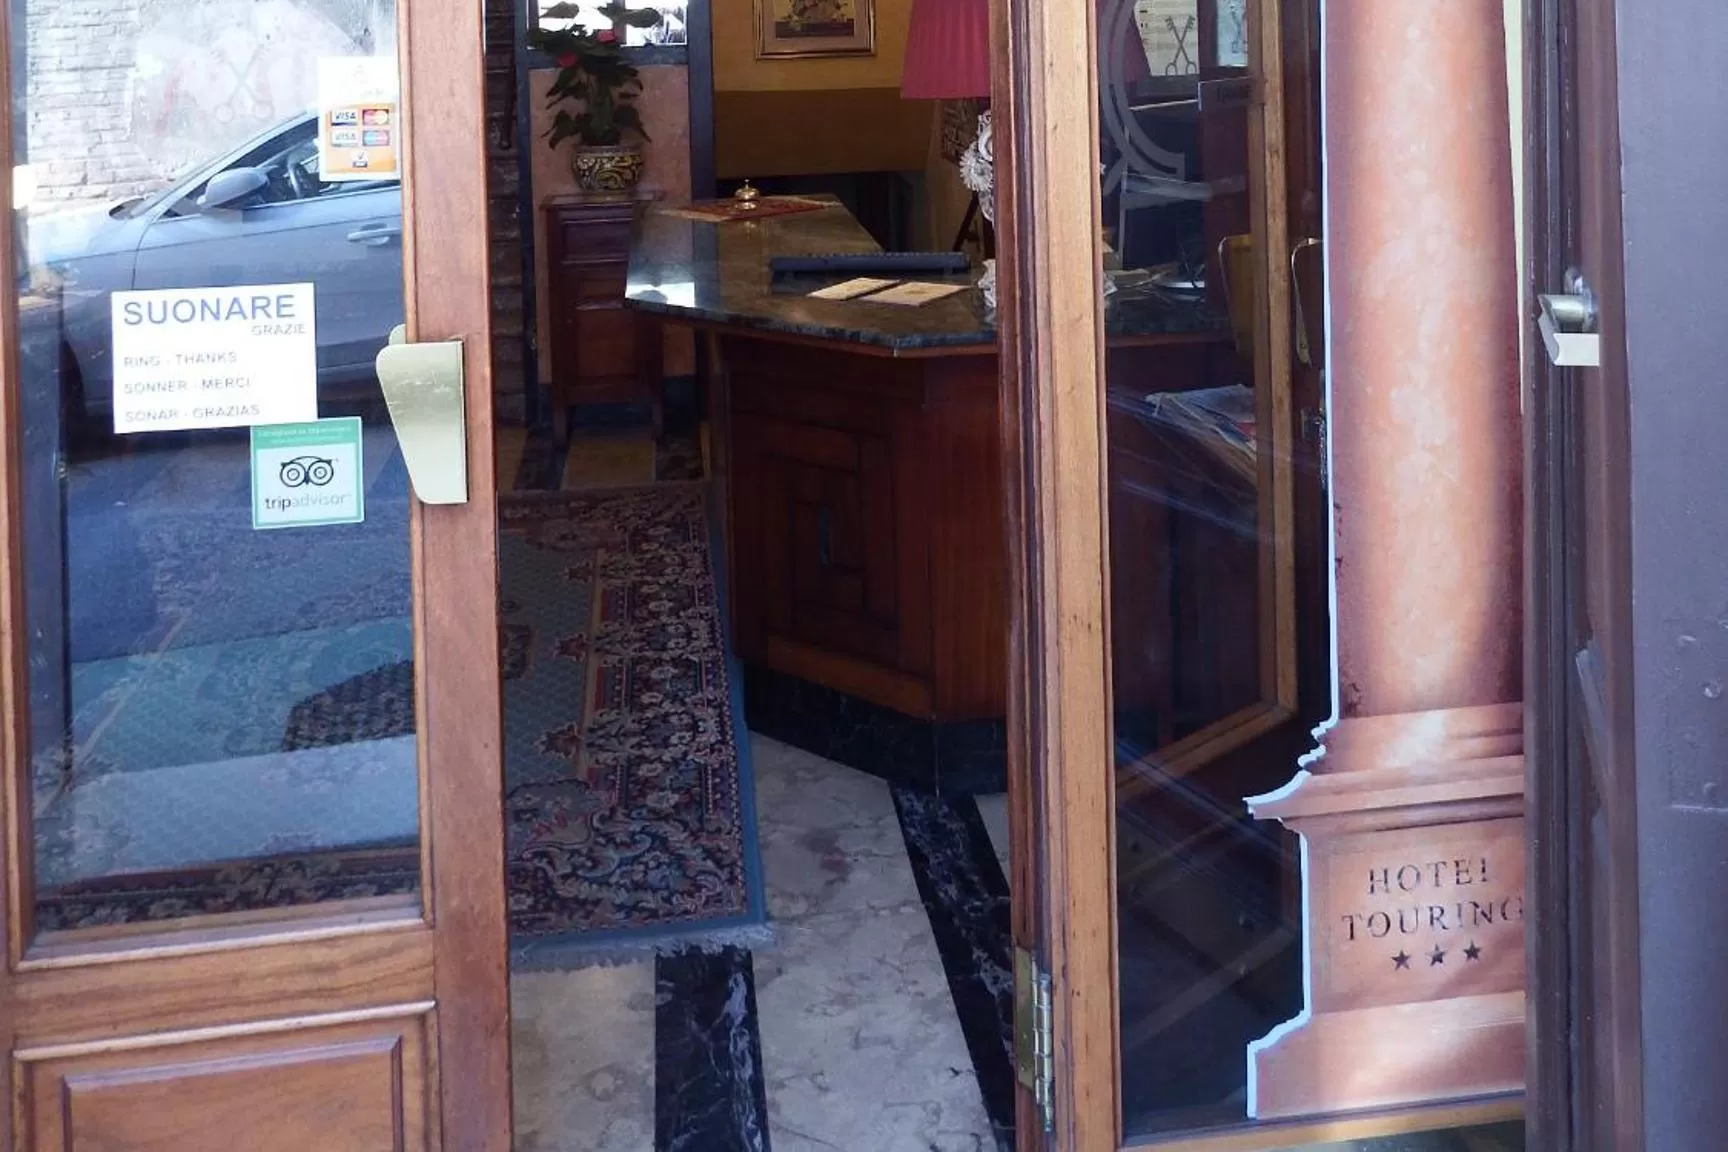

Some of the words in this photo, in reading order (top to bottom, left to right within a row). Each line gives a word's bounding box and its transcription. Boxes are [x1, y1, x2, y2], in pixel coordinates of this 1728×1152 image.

[335, 111, 357, 121] VISA
[123, 294, 296, 326] SUONARE
[251, 323, 307, 337] GRAZIE
[123, 355, 161, 368] RING
[175, 351, 238, 365] THANKS
[123, 379, 188, 395] SONNER
[201, 376, 252, 391] MERCI
[125, 408, 179, 423] SONAR
[192, 404, 261, 419] GRAZIAS
[265, 493, 347, 512] tripadvisor
[1341, 896, 1524, 941] TOURING
